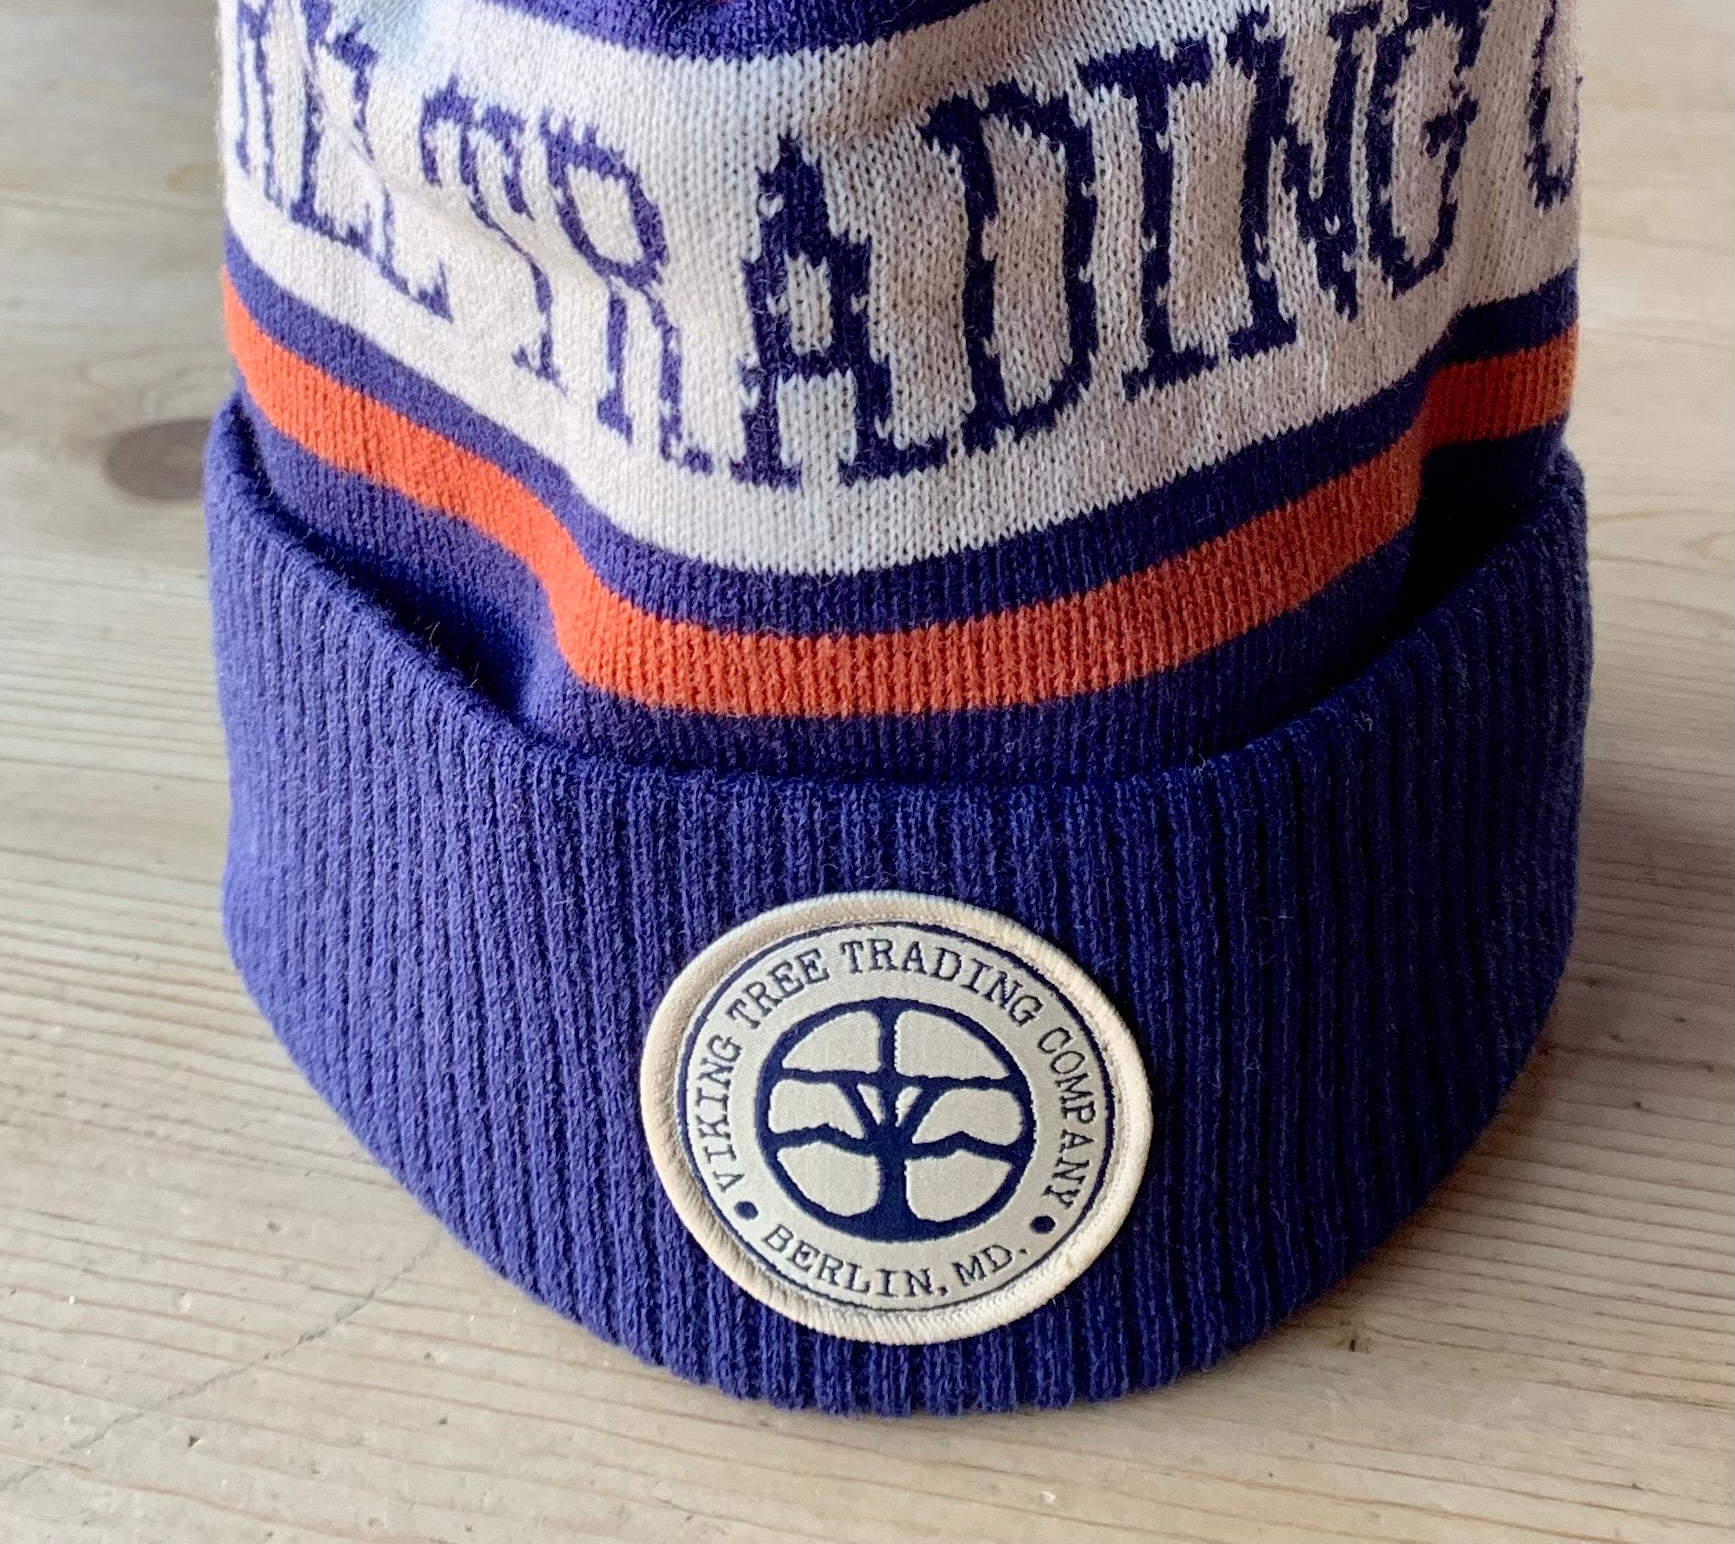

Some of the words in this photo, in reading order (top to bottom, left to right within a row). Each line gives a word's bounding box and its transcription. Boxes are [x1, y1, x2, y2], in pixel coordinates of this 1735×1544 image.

[697, 1033, 744, 1194] VIKING
[725, 947, 831, 1031] TREE
[840, 938, 1043, 1028] TRADING
[1037, 1026, 1097, 1209] COMPANY
[761, 1223, 948, 1299] BERLIN,
[955, 1241, 1029, 1288] MD.
